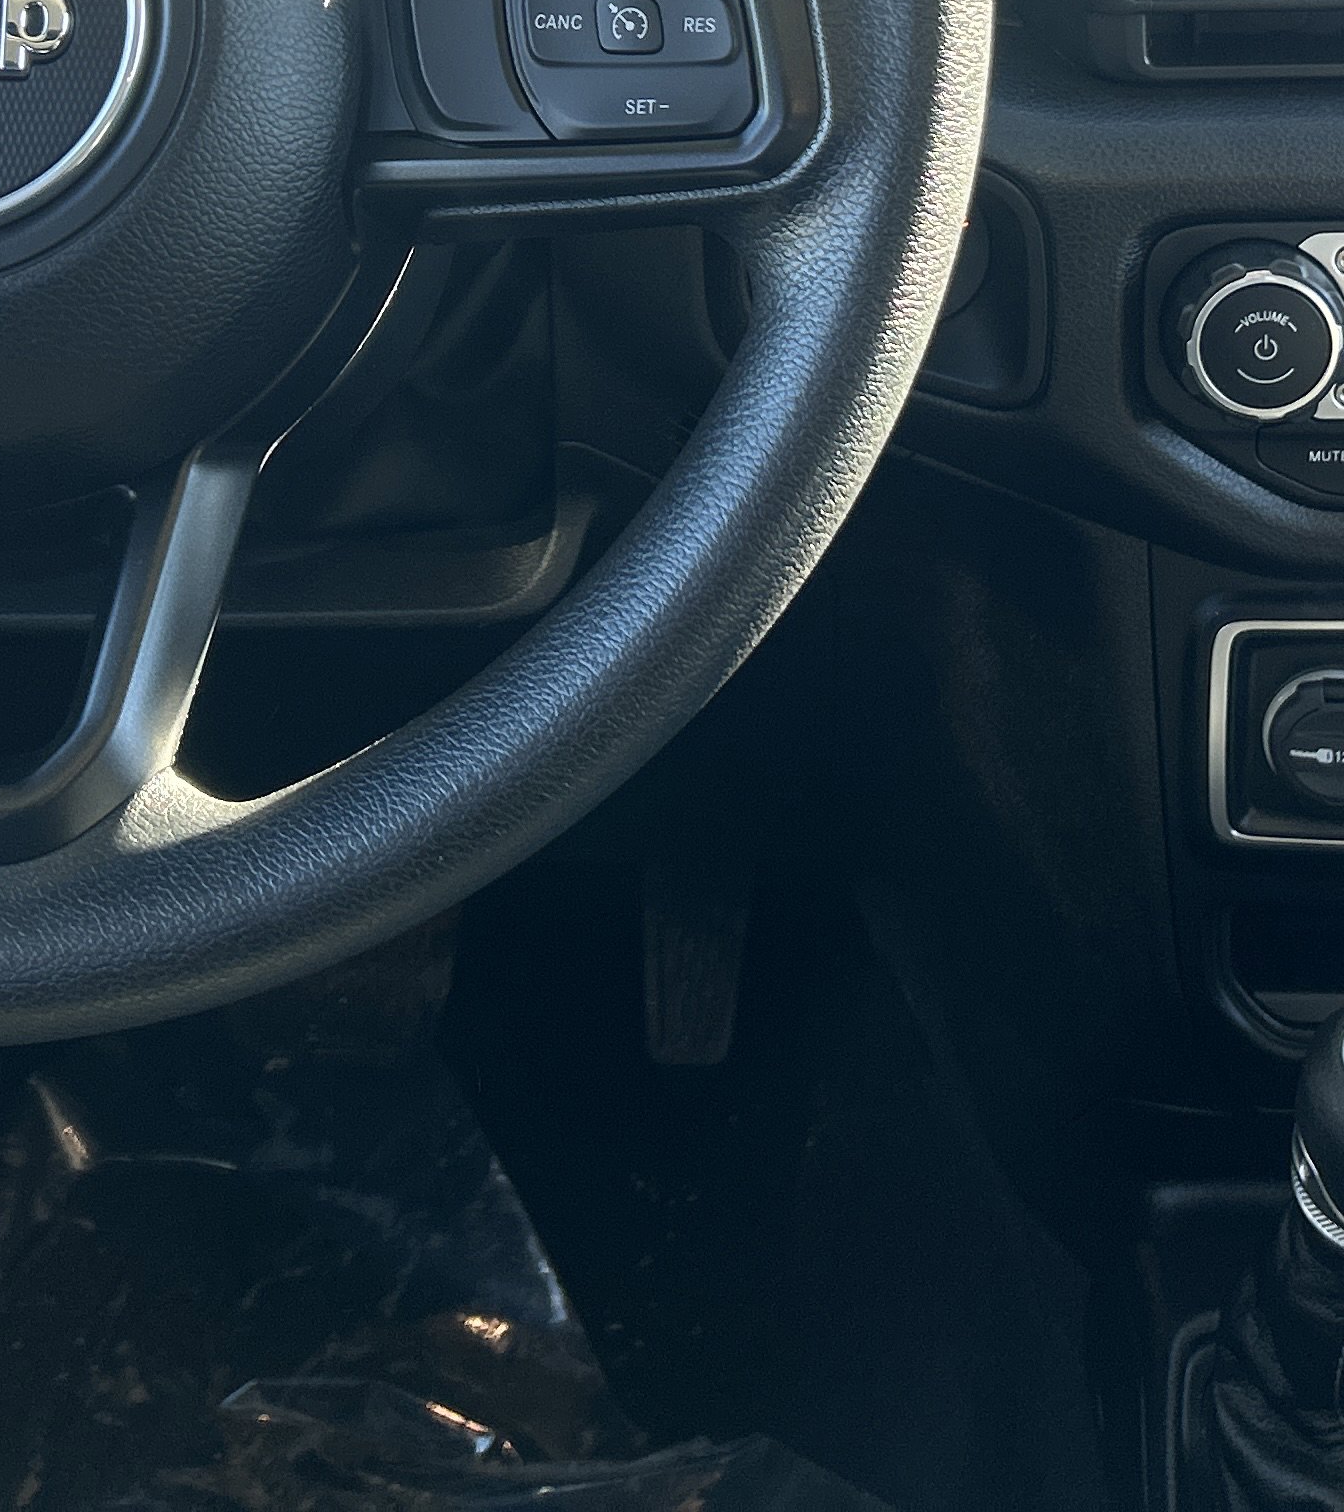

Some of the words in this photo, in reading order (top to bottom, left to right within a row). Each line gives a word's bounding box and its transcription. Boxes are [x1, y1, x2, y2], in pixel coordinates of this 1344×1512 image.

[534, 13, 583, 30] CANC
[682, 17, 717, 34] RES
[1240, 310, 1290, 327] VOLUME
